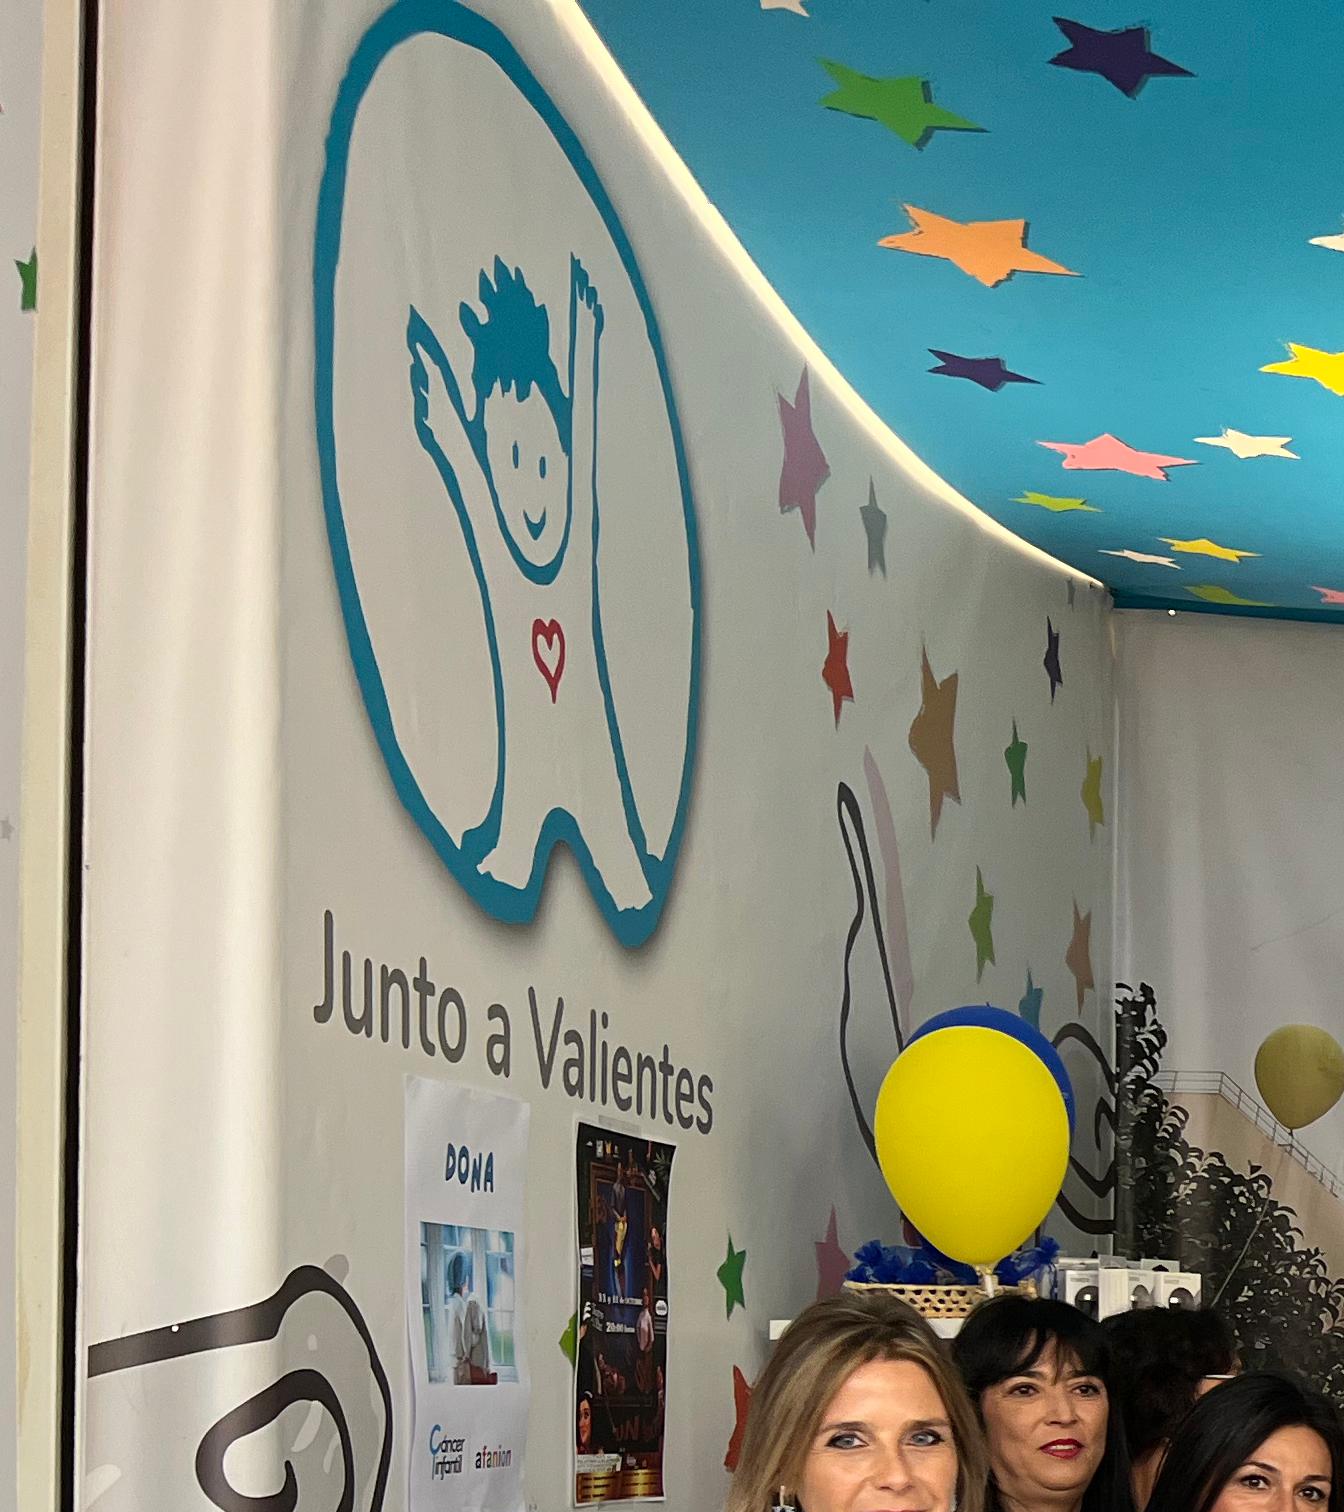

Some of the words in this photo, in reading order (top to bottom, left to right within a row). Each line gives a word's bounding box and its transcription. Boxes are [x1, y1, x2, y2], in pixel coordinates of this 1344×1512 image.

[313, 909, 467, 1063] Junto
[486, 1003, 511, 1078] a
[528, 986, 714, 1135] Valientes
[445, 1143, 494, 1193] DONA
[475, 1443, 513, 1470] afanion
